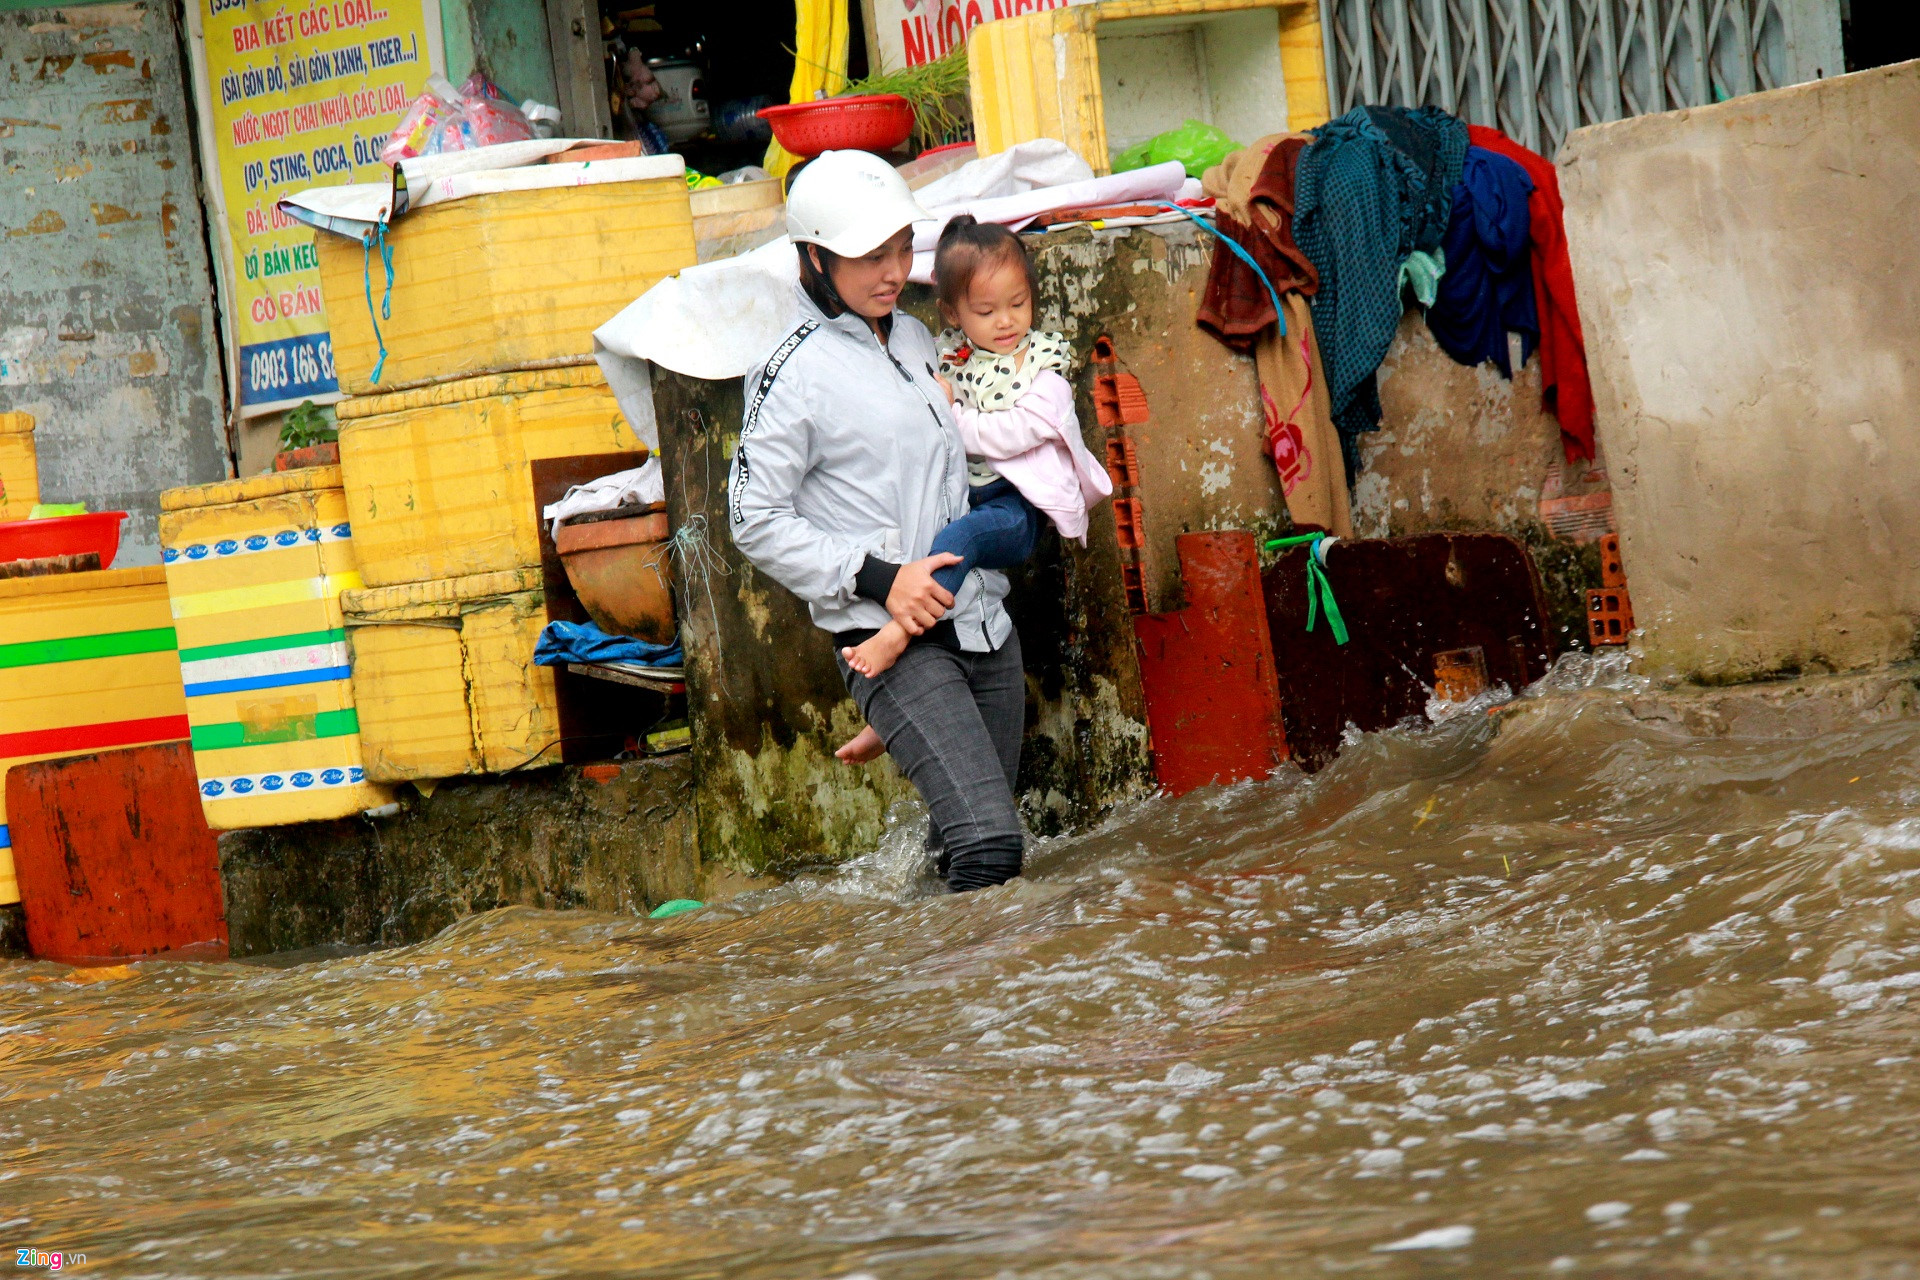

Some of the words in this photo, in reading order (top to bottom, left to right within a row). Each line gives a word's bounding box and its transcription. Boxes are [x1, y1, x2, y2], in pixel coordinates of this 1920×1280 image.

[232, 23, 261, 53] BIA
[263, 5, 294, 46] KẾT
[298, 2, 330, 37] CÁC
[221, 68, 242, 106] (SÀI
[242, 64, 265, 98] GÒN
[288, 53, 308, 88] SÀI
[308, 48, 332, 82] GÒN
[332, 45, 368, 76] XANH,
[367, 32, 418, 68] TIGER...)
[232, 110, 261, 146] NƯỚC
[261, 108, 291, 141] NGỌT
[293, 102, 320, 132] CHAI
[320, 91, 352, 128] NHỰA
[353, 84, 377, 120] CÁC
[269, 152, 312, 184] STING,
[313, 143, 353, 175] COCA,
[246, 200, 269, 235] ĐÁ:
[263, 243, 291, 277] BÁN
[251, 289, 277, 323] CÓ
[279, 283, 321, 318] BÁN
[250, 348, 288, 392] 0903
[291, 342, 319, 385] 166
[733, 463, 749, 524] GIVENCHY
[766, 332, 802, 377] GIVENCHY
